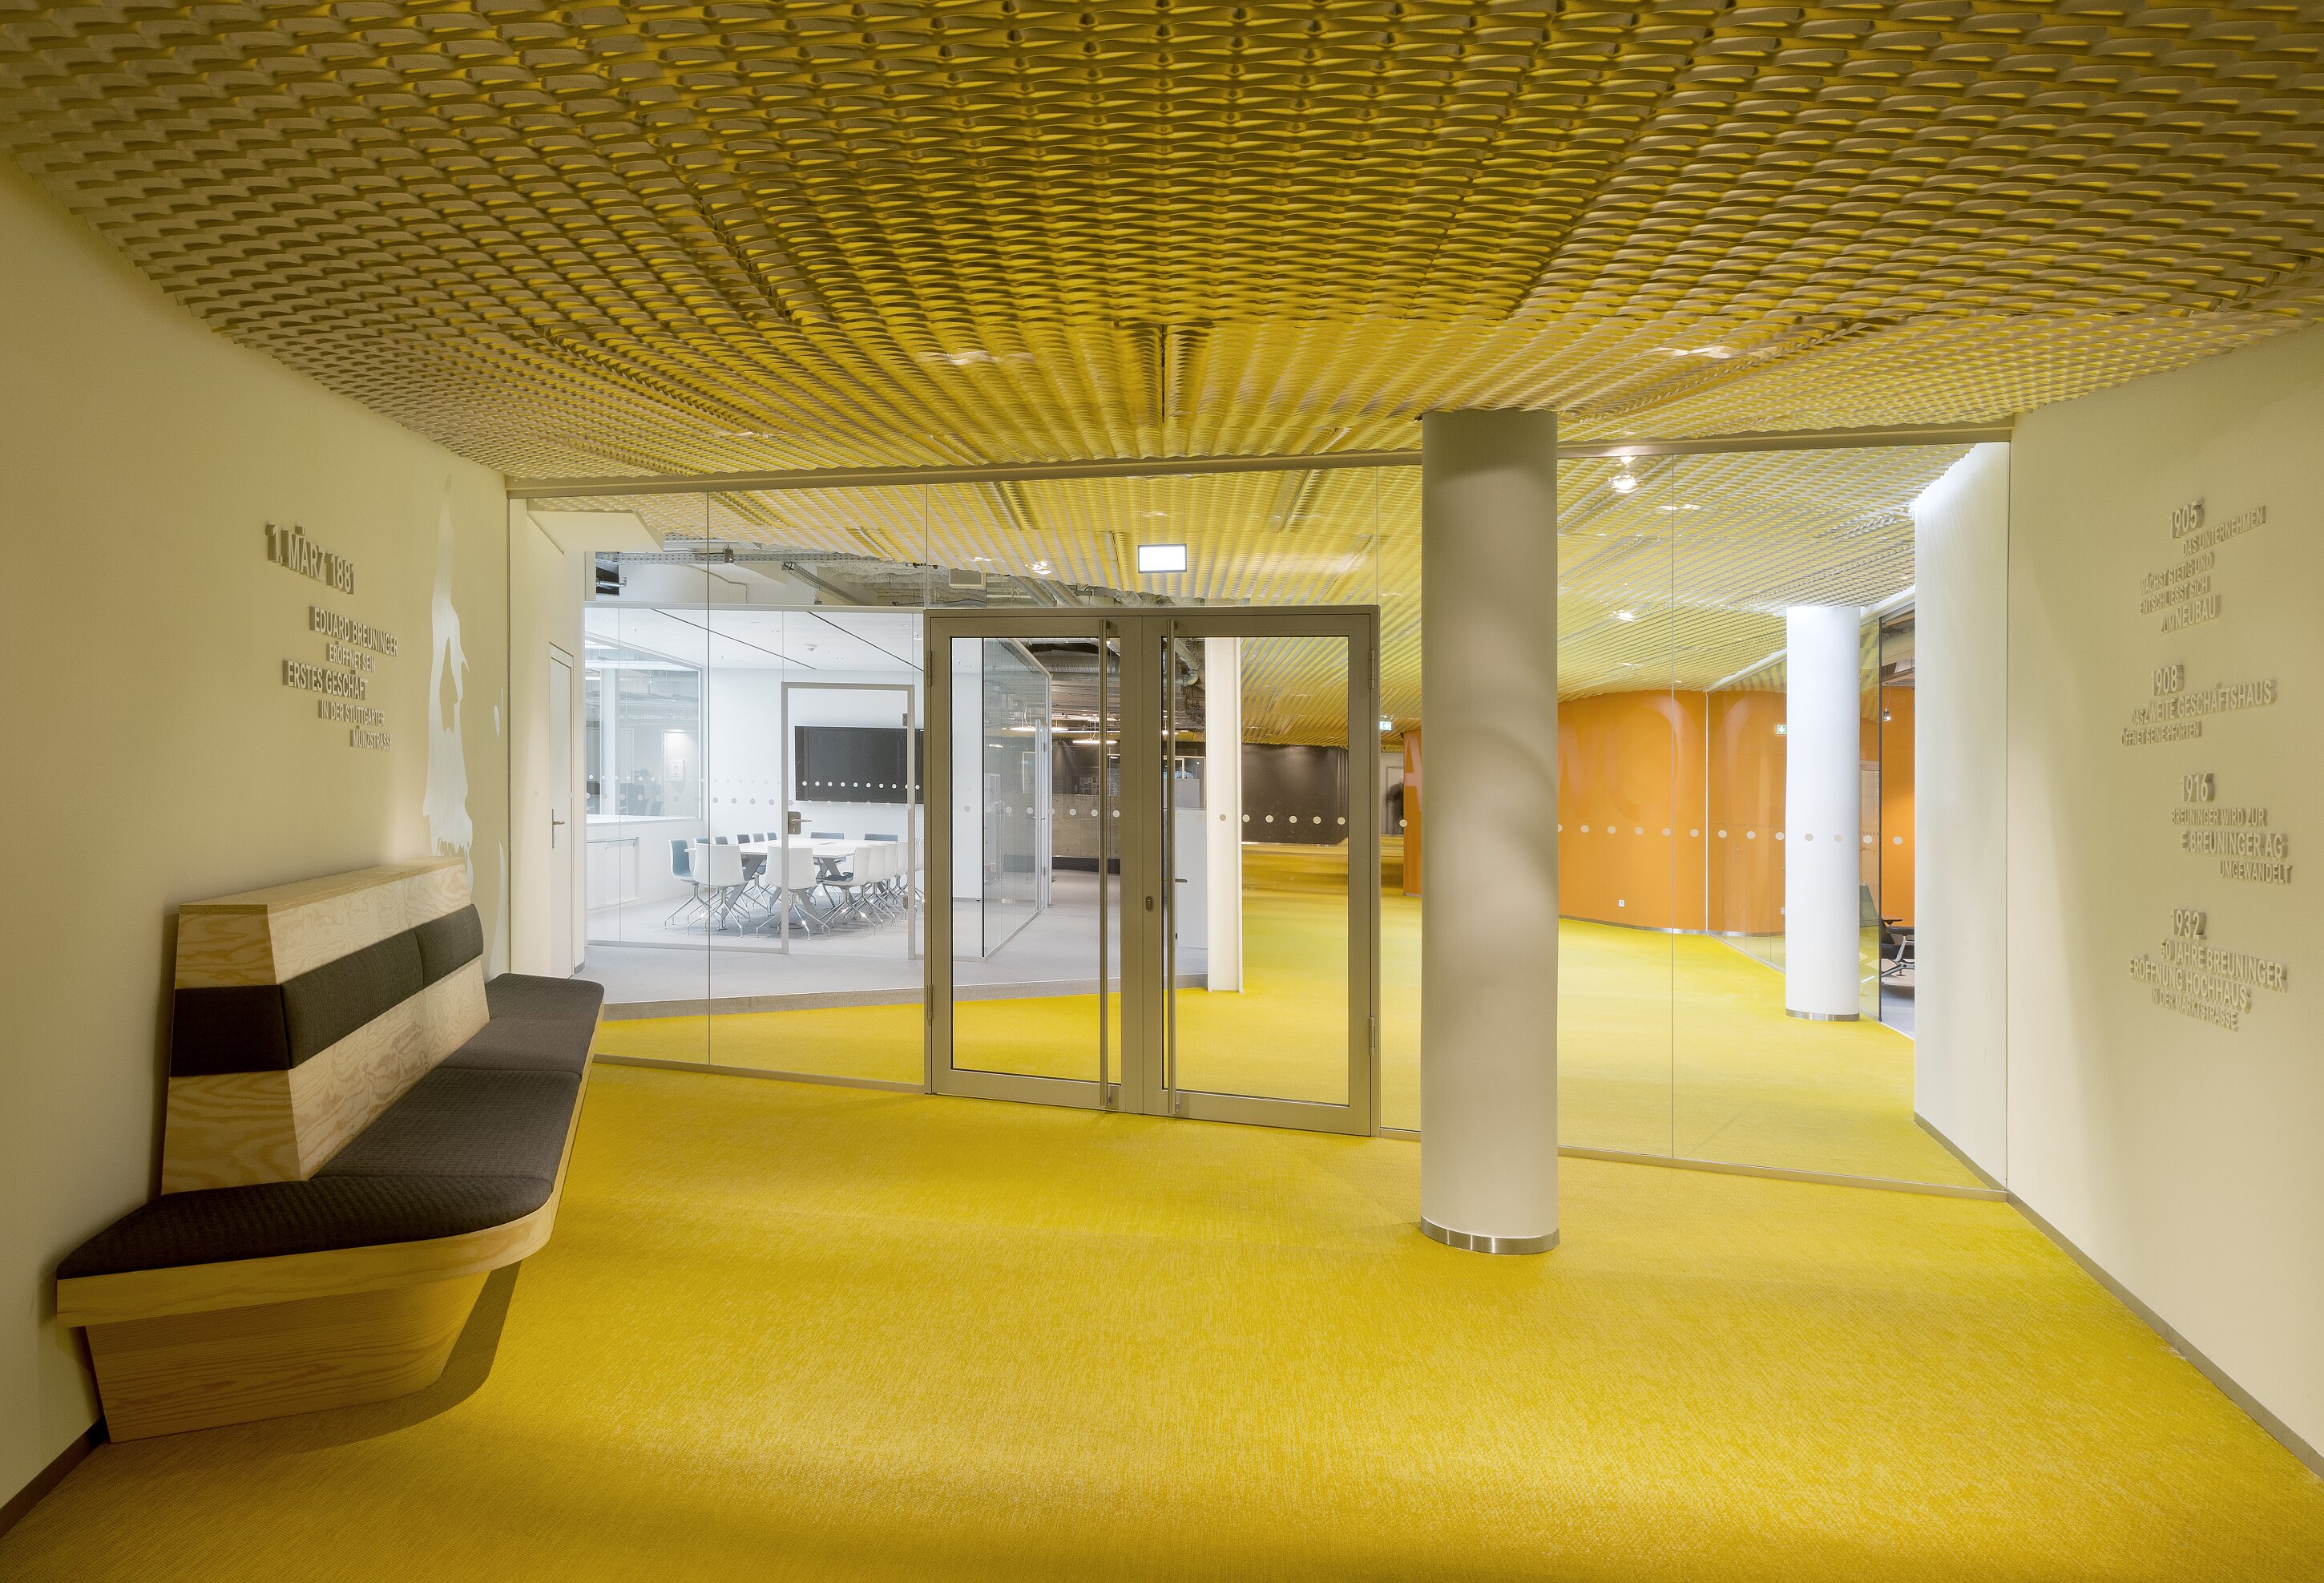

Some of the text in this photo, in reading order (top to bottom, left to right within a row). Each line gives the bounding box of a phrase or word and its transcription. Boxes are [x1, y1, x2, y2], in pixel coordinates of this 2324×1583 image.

[2170, 499, 2199, 539] 1905
[2182, 506, 2264, 557] DAS UNTERNEHMEN
[287, 526, 326, 582] MÄRZ
[330, 553, 355, 595] 1881
[2140, 552, 2213, 596] WÄCHST STETIG UND
[2140, 576, 2208, 616] ENTSCHLIESST SICH
[2175, 596, 2217, 631] NEUBAU
[313, 607, 398, 656] EDUARD BREUNINGER
[329, 641, 376, 673] ERÖFFNET SEIN
[288, 660, 368, 701] ERSTES GESCHÄFT
[2151, 664, 2179, 697] 1908
[321, 700, 385, 727] IN DER STUTTGARTER
[2132, 680, 2272, 726] DAS ZWEITE GESCHÄFTSHAUS
[352, 725, 393, 750] MÜNZSTRASSE
[2122, 721, 2199, 747] ÖFFNET SEINE PFORTEN
[2180, 773, 2210, 802] 1916
[2172, 807, 2265, 826] BREUNINGER WIRD ZUR
[2189, 830, 2261, 856] BREUNINGER
[2265, 832, 2284, 858] AG
[2219, 860, 2292, 884] UMGEWANDELT
[2171, 909, 2201, 940] 1932
[2129, 954, 2248, 1011] ERÖFFNUNG HOCHHAUS
[2161, 939, 2284, 989] 50 JAHRE BREUNINGER
[2159, 990, 2173, 1010] DER
[2175, 993, 2237, 1031] MARKTSTRASSE
